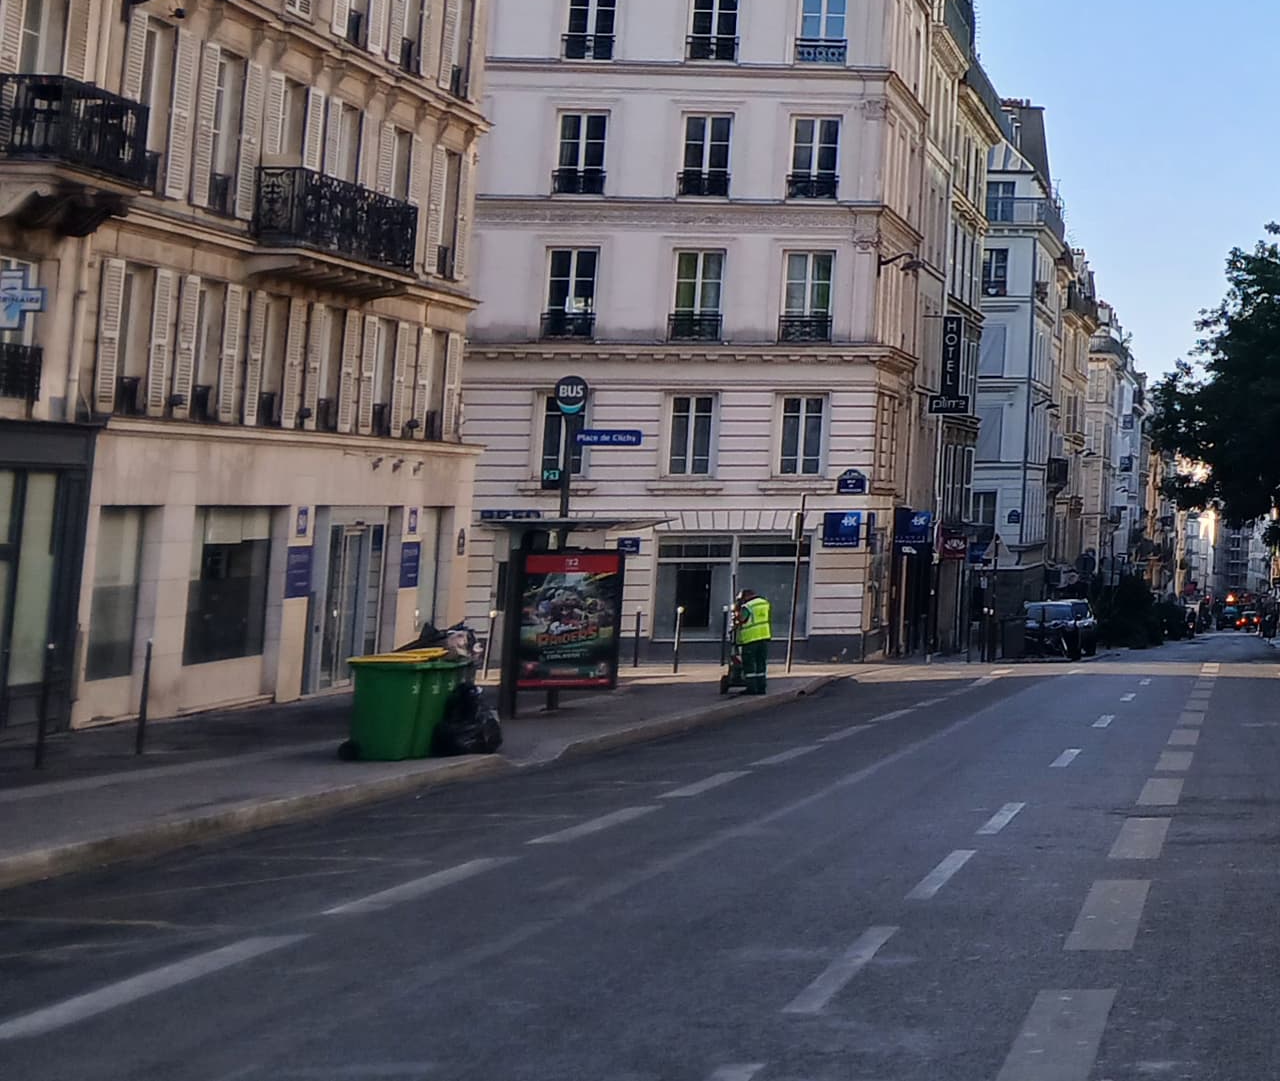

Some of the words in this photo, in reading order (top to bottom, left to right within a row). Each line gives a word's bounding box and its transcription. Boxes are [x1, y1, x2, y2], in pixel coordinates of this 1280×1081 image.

[559, 385, 584, 397] BUS
[576, 433, 598, 442] Place
[600, 433, 611, 441] de
[612, 432, 636, 443] Clichy
